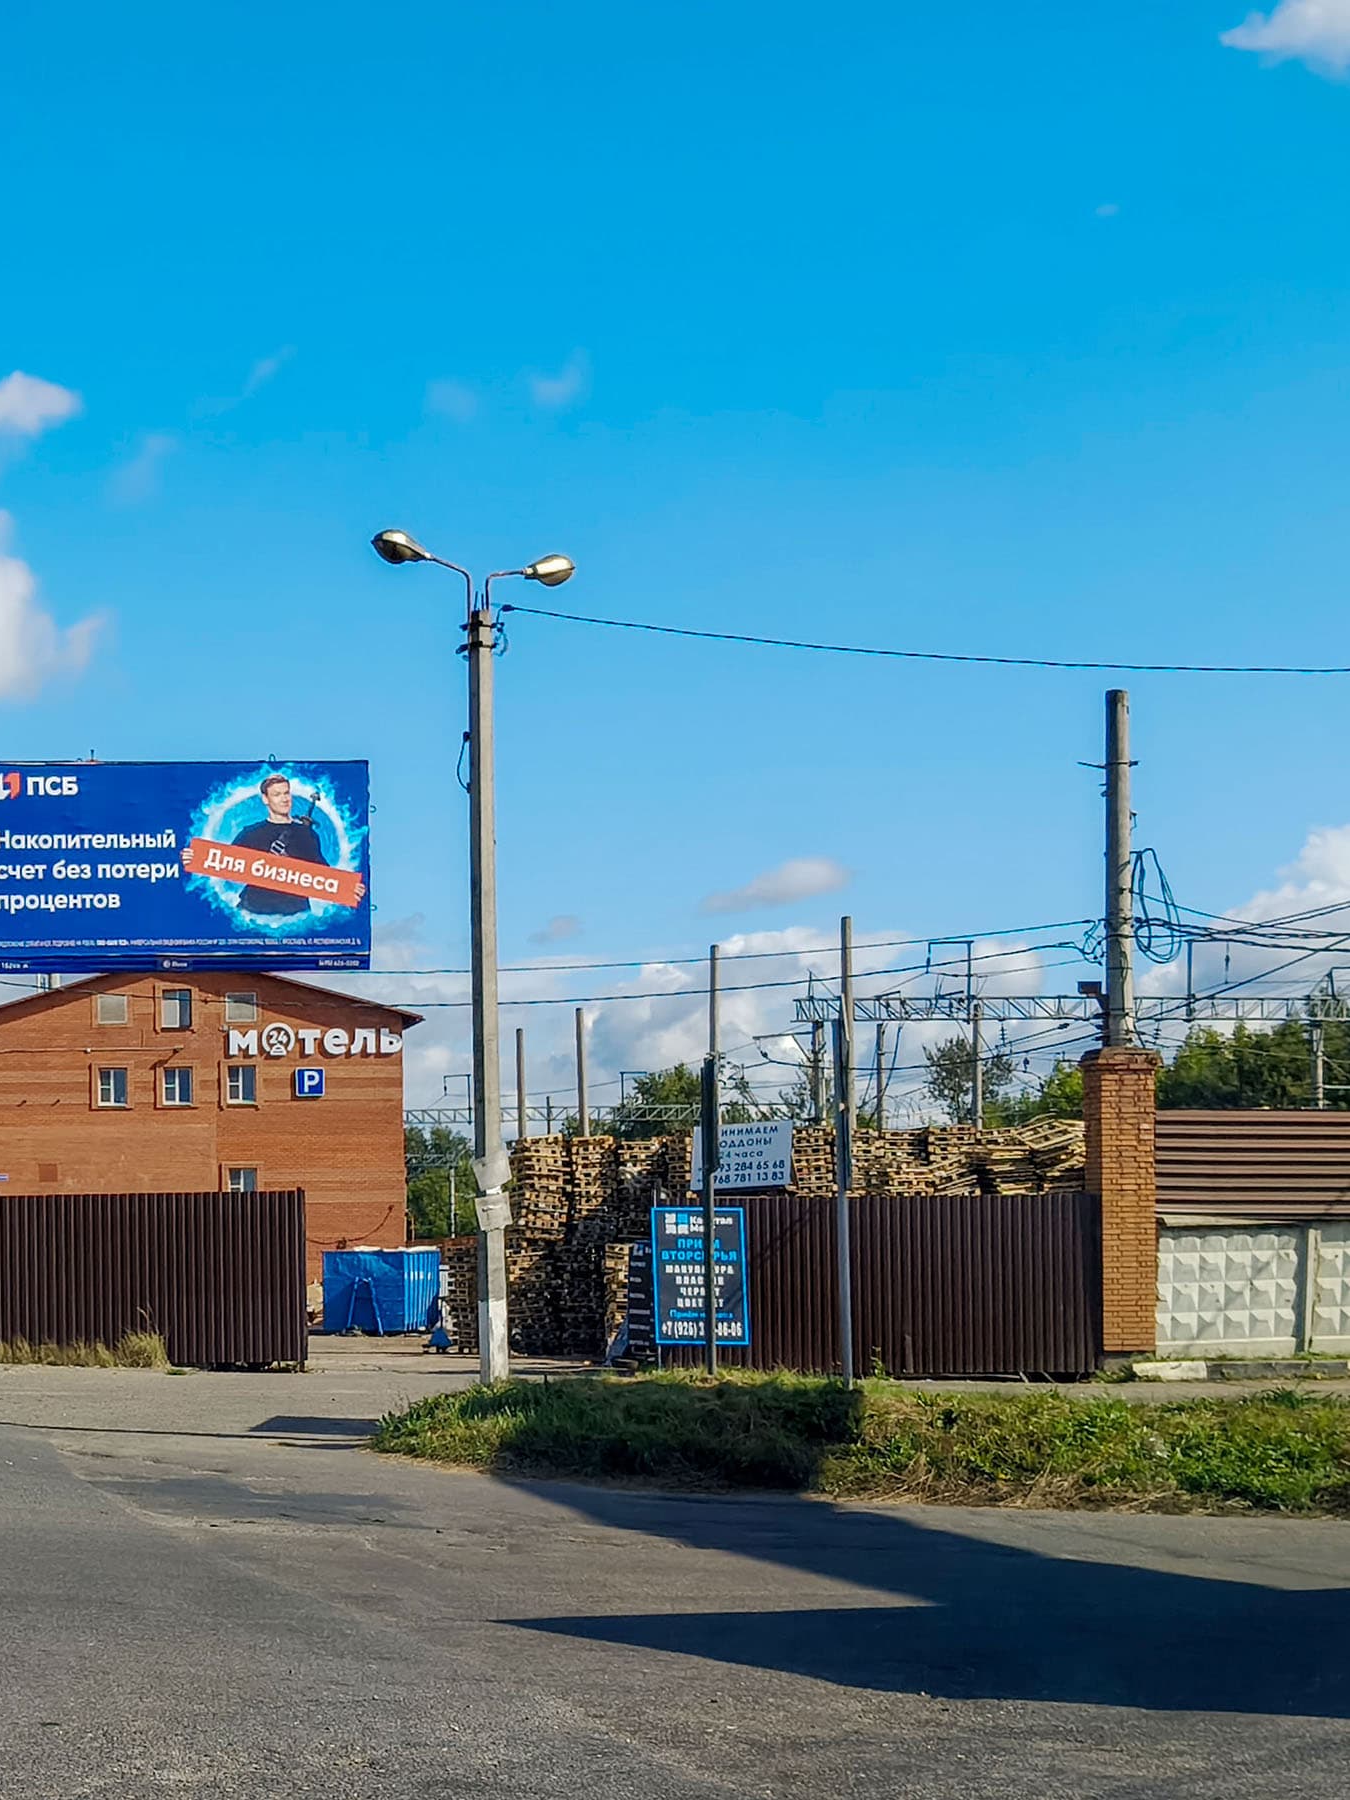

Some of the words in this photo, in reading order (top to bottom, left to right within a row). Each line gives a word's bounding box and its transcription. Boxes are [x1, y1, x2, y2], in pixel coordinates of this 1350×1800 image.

[26, 776, 79, 796] ПСБ
[52, 859, 92, 879] без
[97, 863, 179, 883] потери
[203, 848, 246, 873] Для
[251, 859, 339, 893] бизнеса
[721, 1126, 778, 1137] ИНИМАЕМ
[719, 1138, 772, 1148] ОДДОНЫ
[734, 1150, 763, 1158] часа
[734, 1162, 753, 1171] 284
[756, 1161, 769, 1170] 65
[772, 1160, 785, 1169] 68
[734, 1173, 751, 1182] 781
[757, 1172, 768, 1181] 13
[771, 1171, 784, 1180] 83
[677, 1238, 720, 1249] ПРИМ
[661, 1250, 737, 1261] ВТОРСРЬЯ
